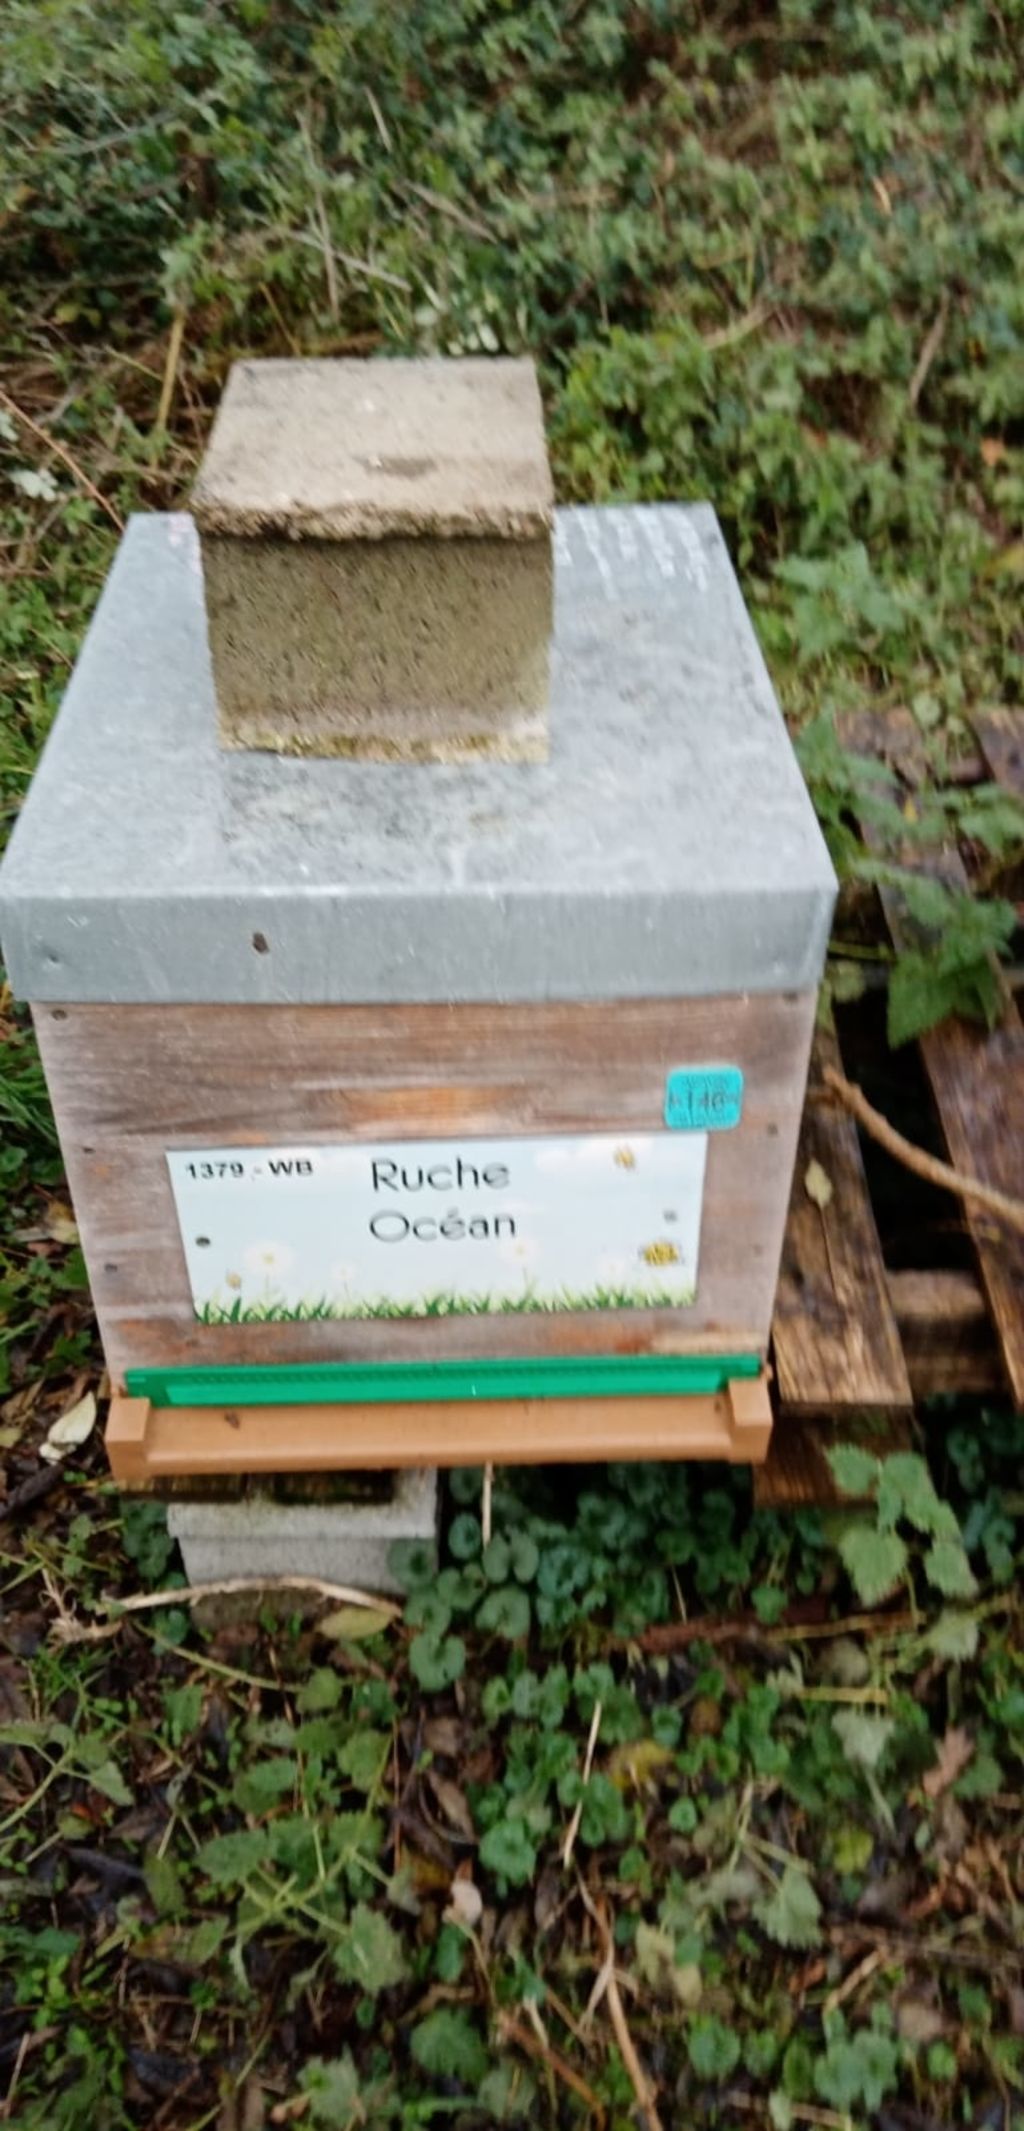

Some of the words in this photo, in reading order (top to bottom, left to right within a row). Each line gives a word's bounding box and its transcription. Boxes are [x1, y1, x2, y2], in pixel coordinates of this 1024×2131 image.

[185, 1161, 245, 1179] 1379
[268, 1157, 314, 1176] WB
[371, 1155, 510, 1193] Ruche
[369, 1206, 517, 1243] Océan
